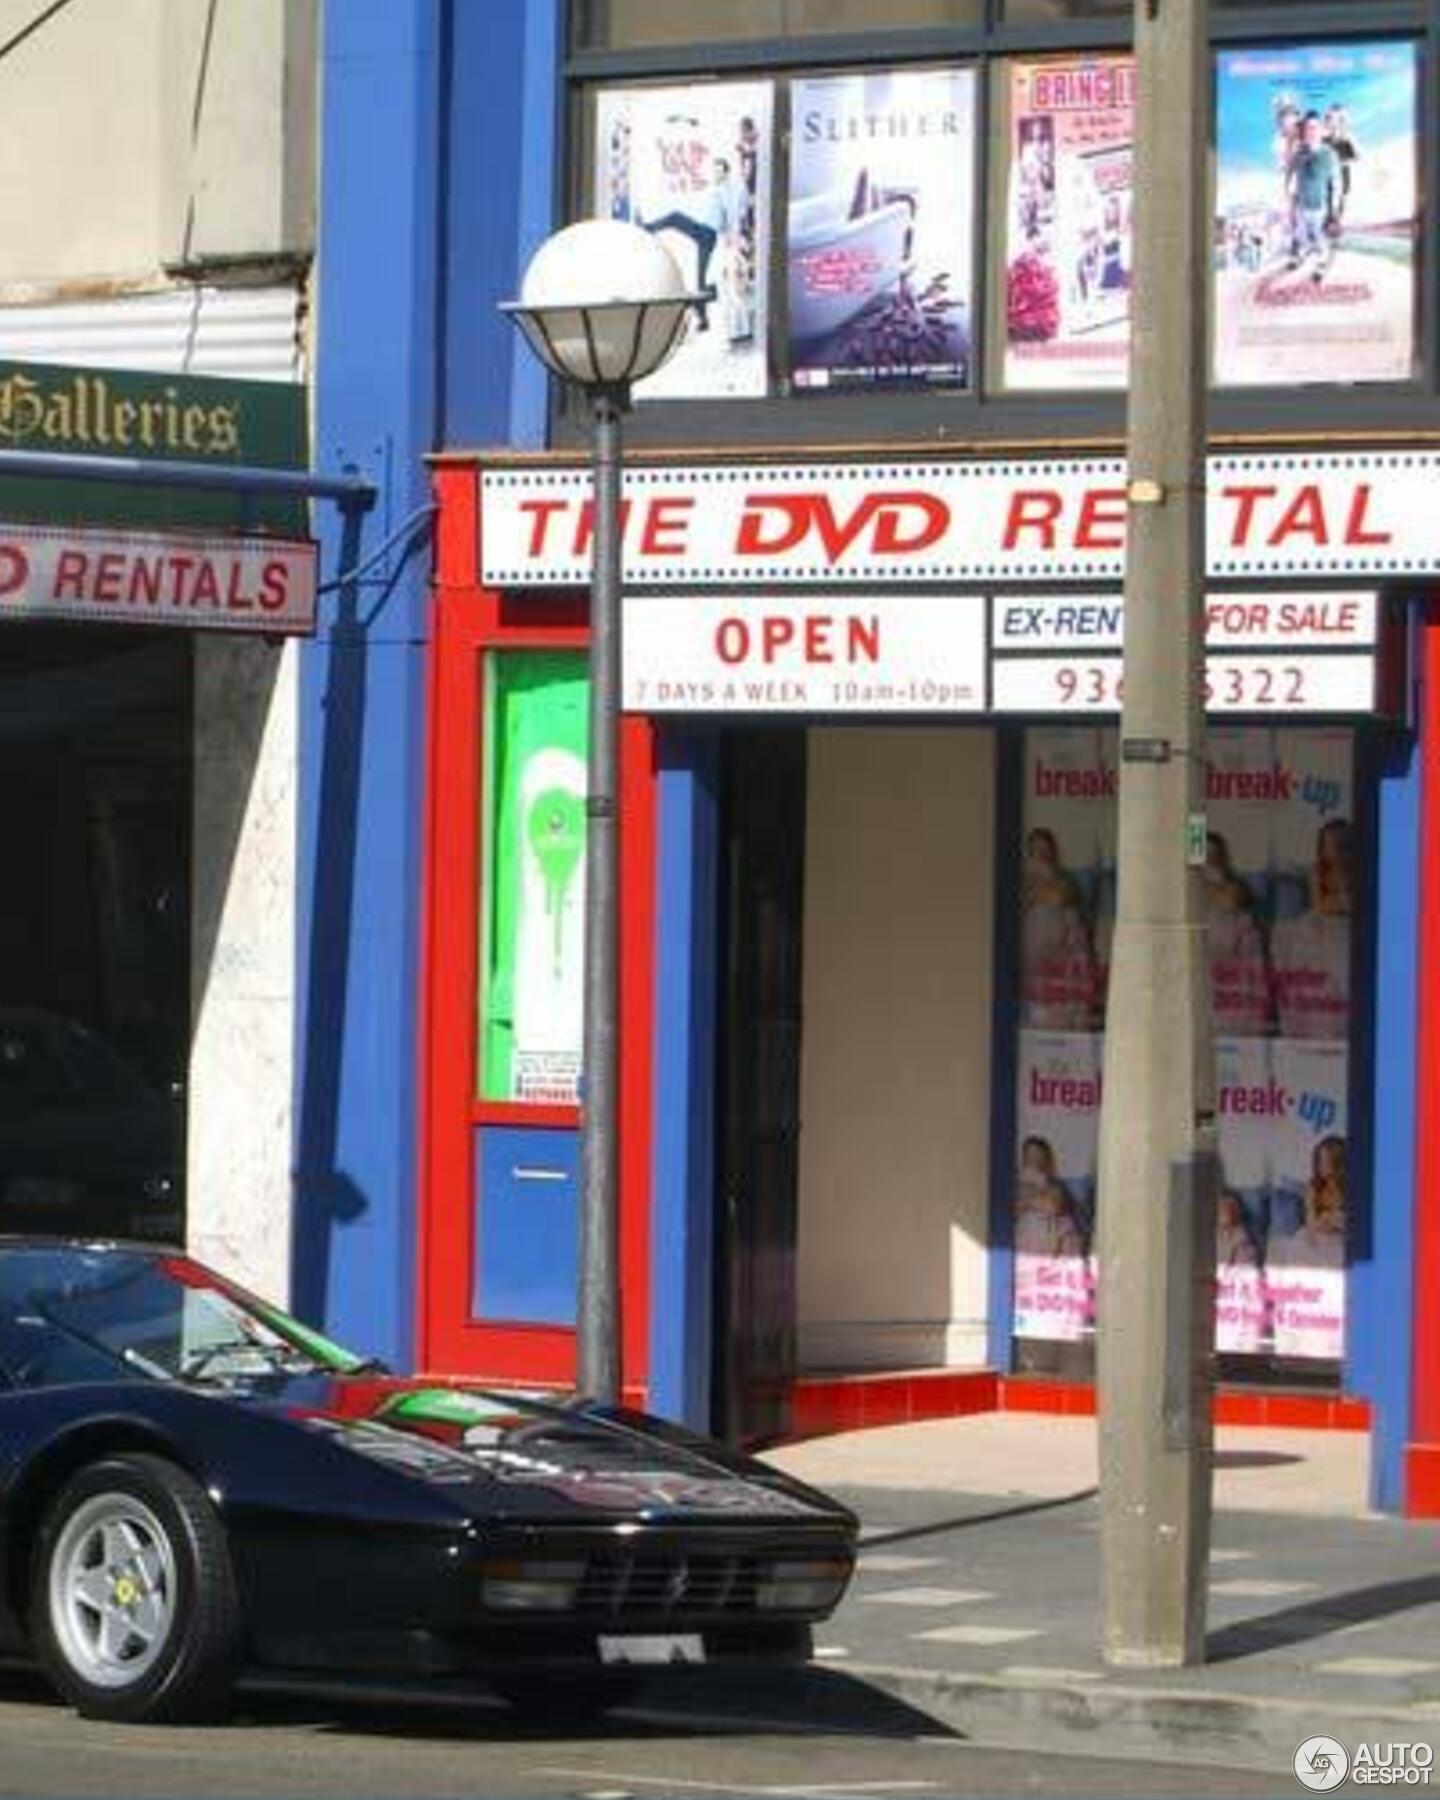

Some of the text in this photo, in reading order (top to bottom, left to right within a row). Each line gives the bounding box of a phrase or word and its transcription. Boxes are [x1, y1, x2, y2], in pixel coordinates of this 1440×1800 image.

[804, 111, 959, 143] SLITHER
[733, 490, 952, 566] DVD
[1000, 485, 1393, 550] RETAL
[53, 551, 288, 611] RENTALS
[1277, 602, 1360, 633] SALE
[715, 615, 880, 664] OPEN
[659, 682, 712, 701] DAYS
[723, 683, 736, 701] A
[745, 682, 807, 701] WEEK
